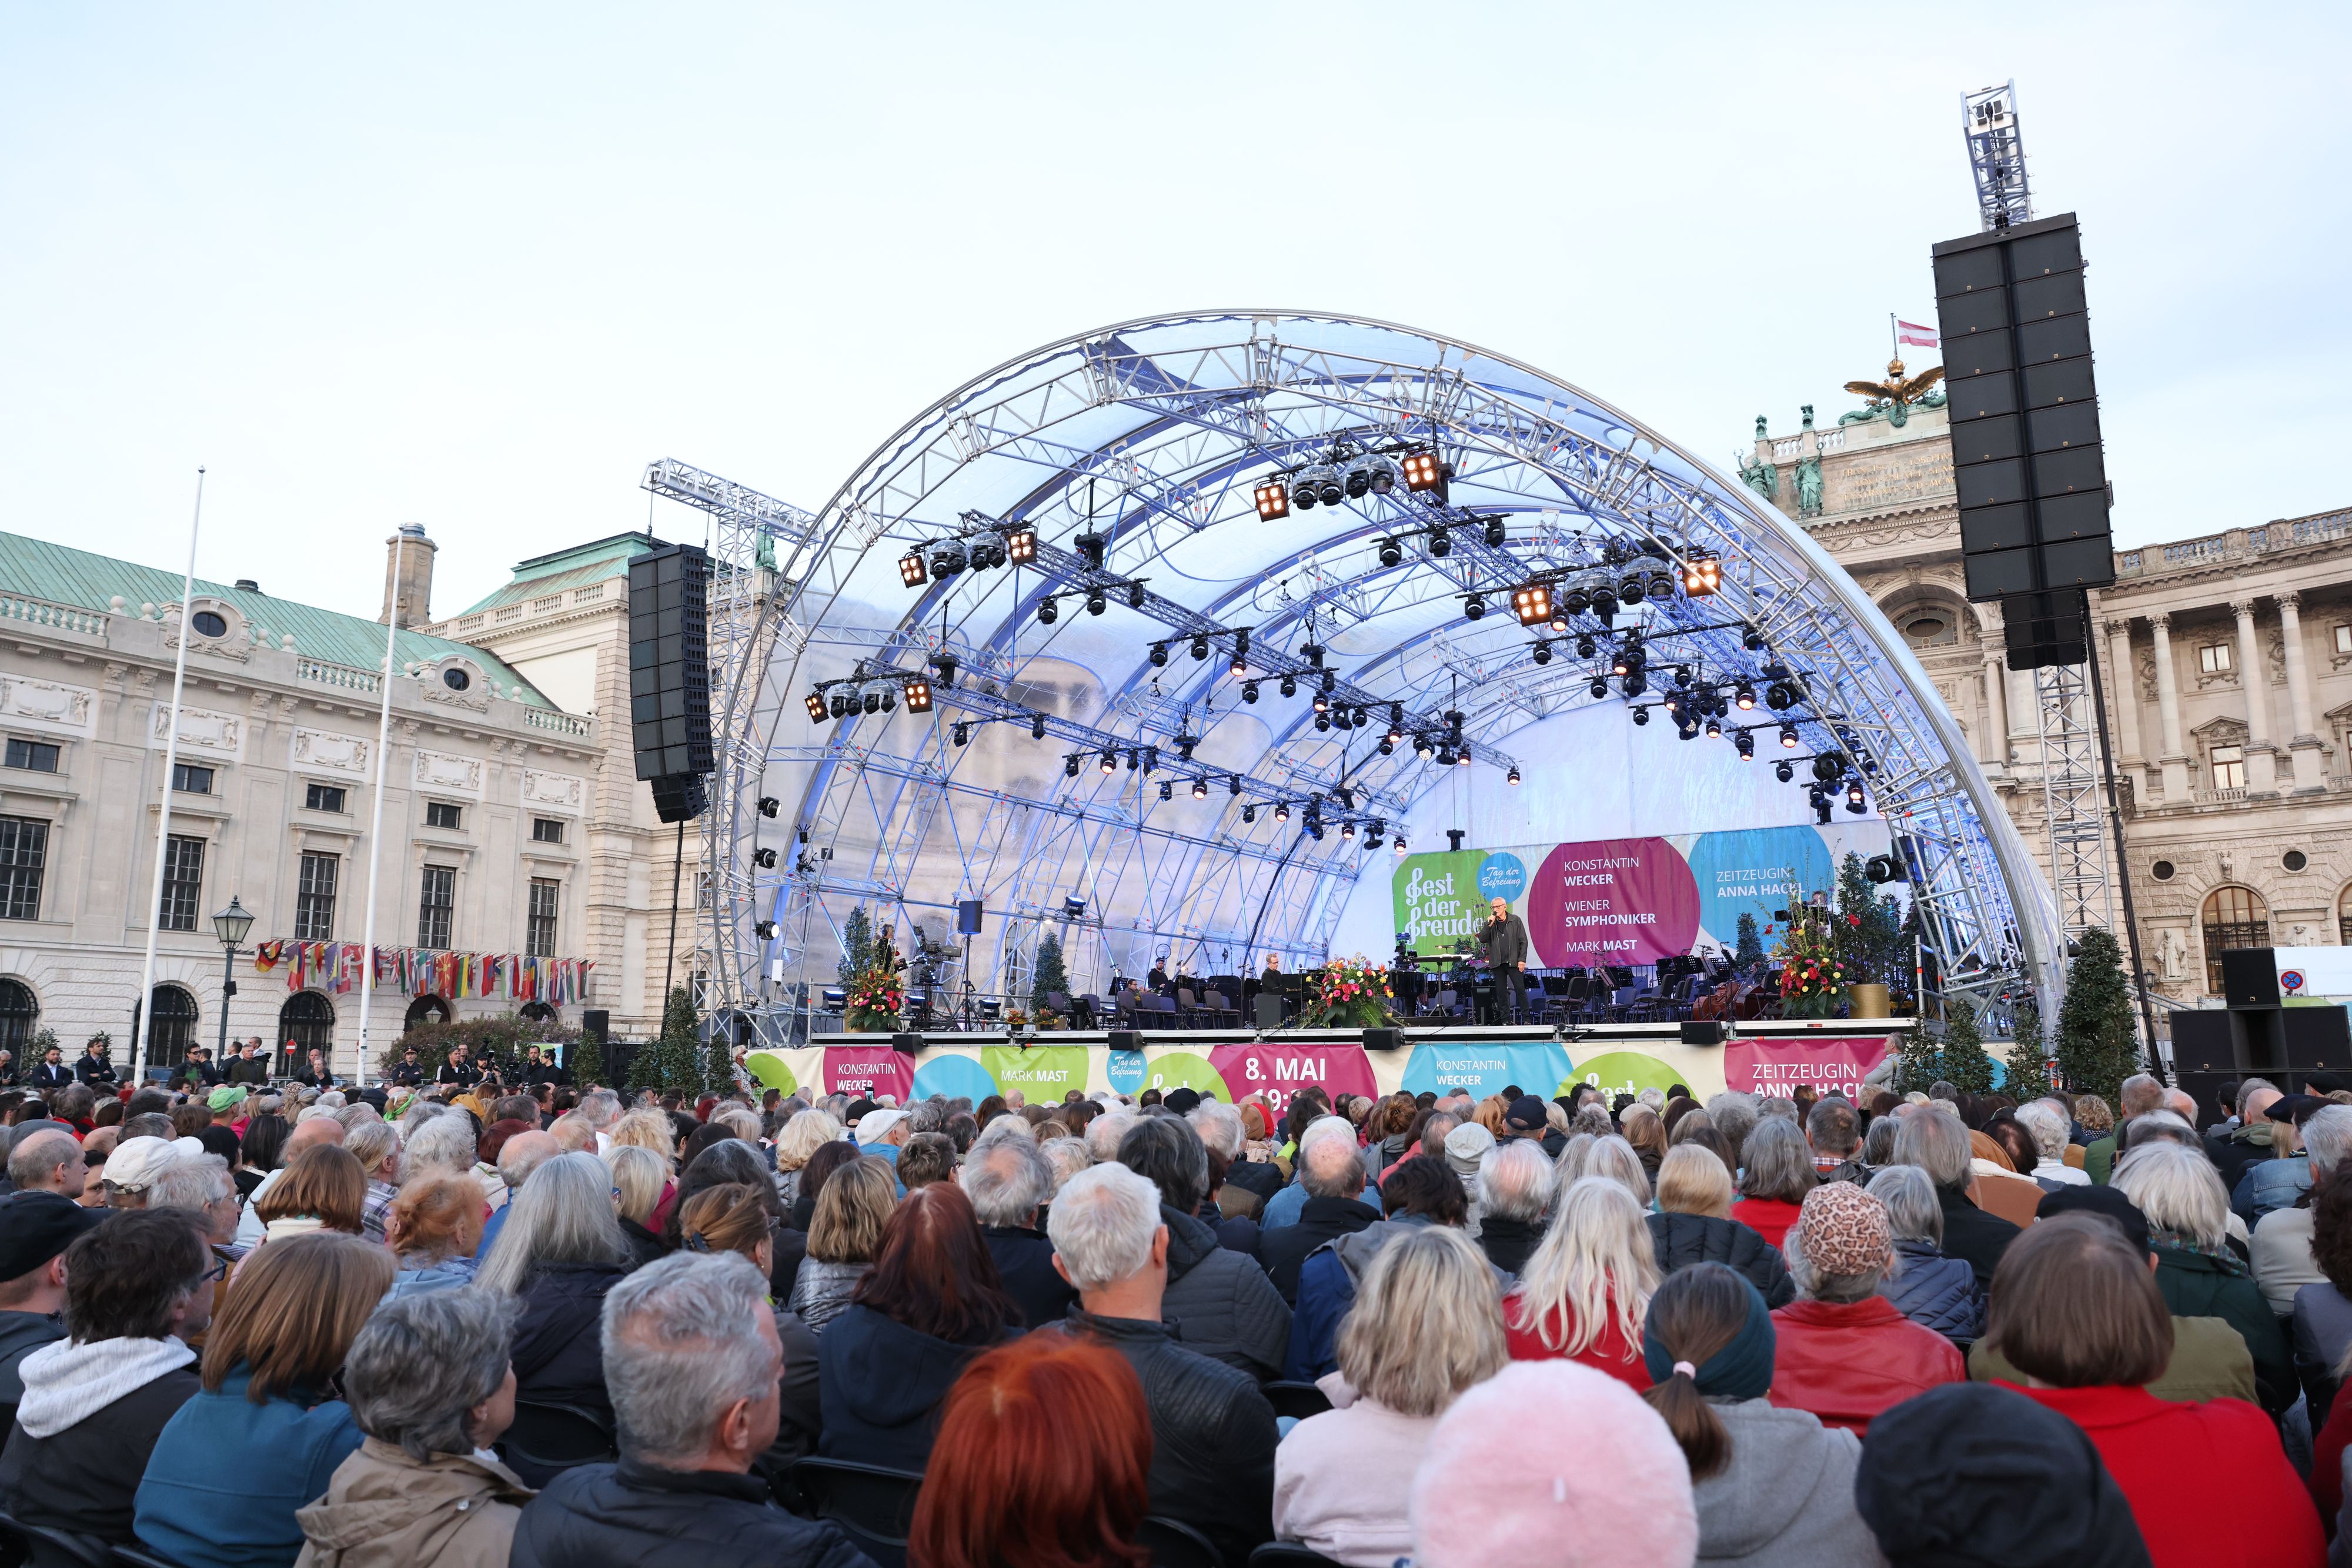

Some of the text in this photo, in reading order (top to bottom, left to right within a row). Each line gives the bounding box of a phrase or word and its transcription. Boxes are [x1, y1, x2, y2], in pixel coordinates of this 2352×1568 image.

[1564, 857, 1639, 871] KONSTANTIN
[1486, 867, 1504, 877] Tag
[1716, 867, 1790, 882] ZEITZEUGIN
[1482, 877, 1521, 889] Befreiung
[1564, 874, 1613, 886] WECKER
[1717, 884, 1758, 898] ANNA
[1424, 897, 1461, 917] der
[1565, 900, 1610, 911] WIENER
[1565, 913, 1656, 927] SYMPHONIKER
[1566, 940, 1637, 952] MARK MAST
[838, 1063, 896, 1075] KONSTANTIN
[1115, 1057, 1141, 1069] Tag der
[1436, 1060, 1506, 1071] KONSTANTIN
[1111, 1065, 1142, 1078] Befreiung
[1245, 1058, 1325, 1081] 8. MAI
[1752, 1063, 1857, 1079] ZEITZEUGIN
[1001, 1070, 1068, 1082] MARK MAST
[1436, 1075, 1482, 1085] WECKER
[837, 1079, 873, 1091] WECKER
[1753, 1082, 1807, 1098] ANN
